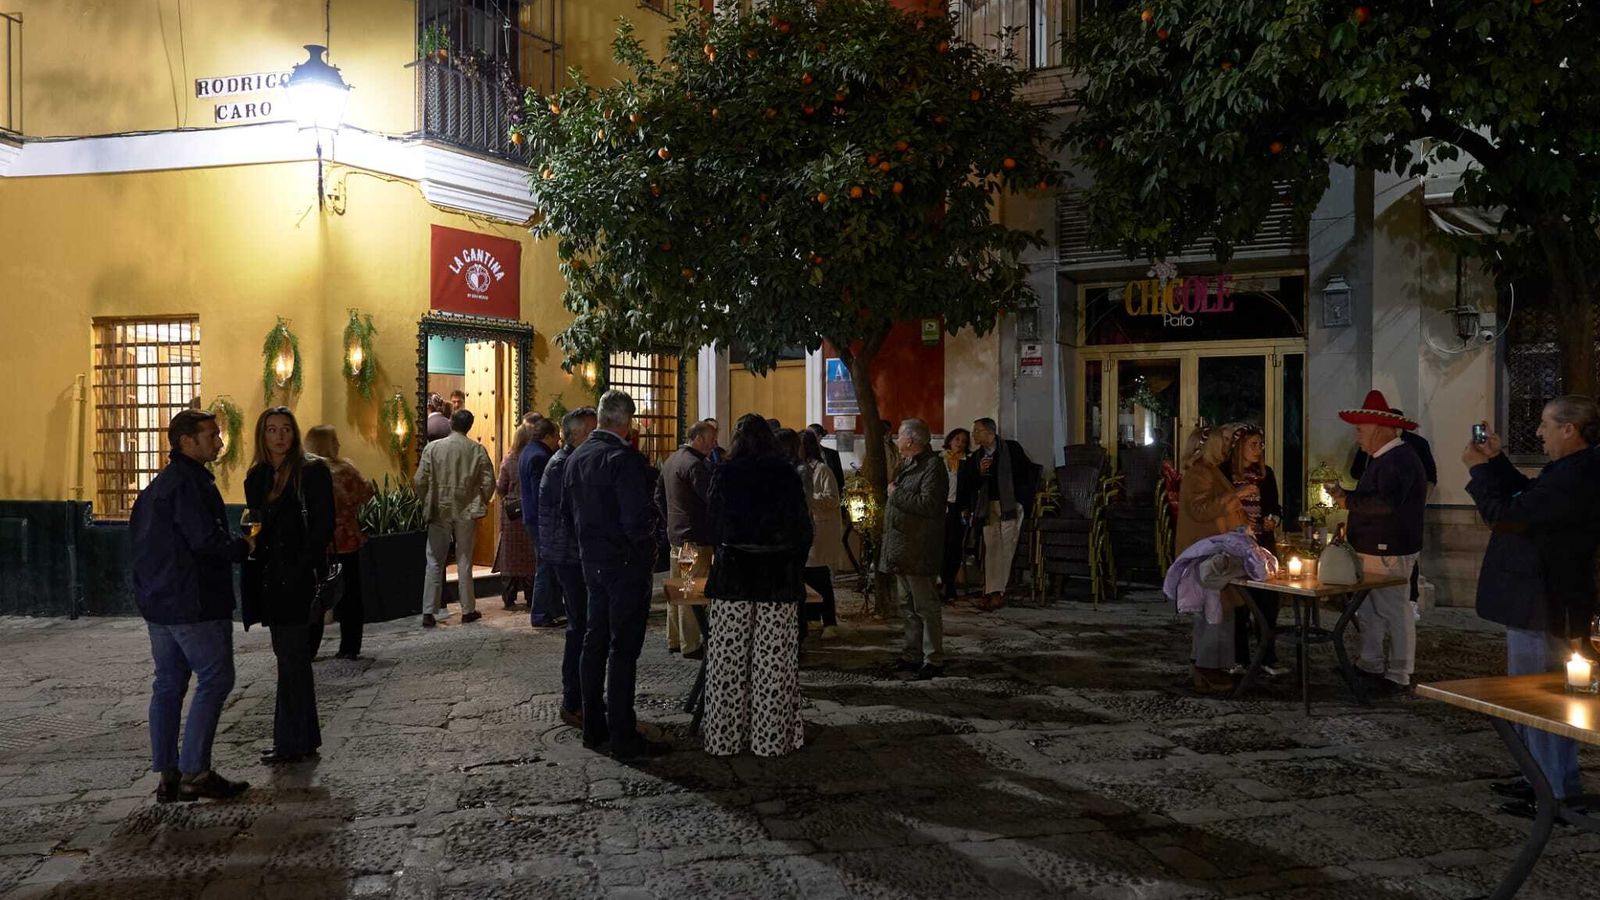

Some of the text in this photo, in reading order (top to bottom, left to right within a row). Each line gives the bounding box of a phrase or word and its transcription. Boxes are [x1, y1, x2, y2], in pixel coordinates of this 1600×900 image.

[198, 73, 291, 96] RODRIGO
[217, 102, 272, 120] CARO
[448, 248, 505, 281] LA CANTINA
[1163, 313, 1194, 327] Patio
